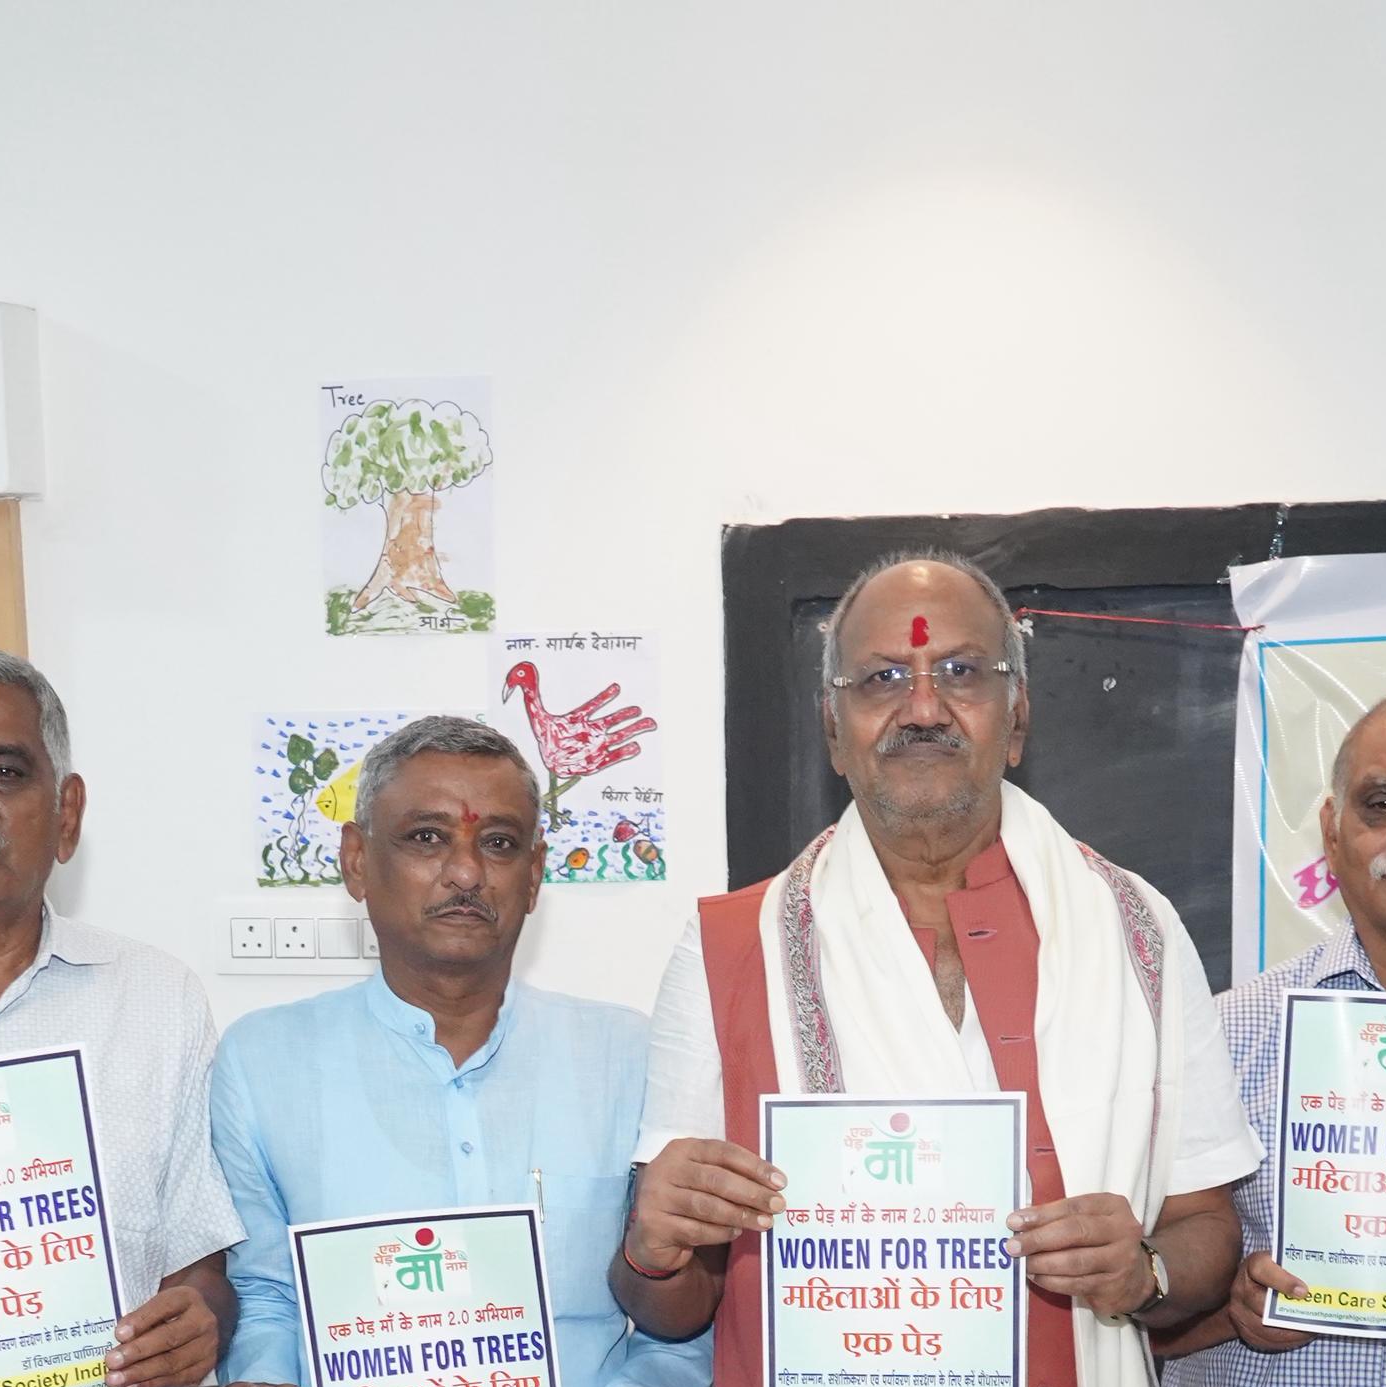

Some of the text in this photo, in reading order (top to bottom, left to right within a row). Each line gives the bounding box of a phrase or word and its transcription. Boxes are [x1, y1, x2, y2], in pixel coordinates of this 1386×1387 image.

[321, 385, 365, 408] Tree
[1292, 1121, 1377, 1155] WOMEN
[19, 1184, 97, 1227] TREES
[785, 1200, 995, 1226] एक पेड़ माँ के नाम 2.0 अभियान
[0, 1239, 33, 1270] के
[40, 1231, 95, 1265] लिए
[777, 1236, 1011, 1270] WOMEN FOR TREES
[0, 1286, 43, 1319] पेड़
[781, 1276, 1003, 1312] महिलाओं के लिए
[327, 1302, 524, 1341] एक पेड़ माँ के नाम 2.0 अभियान
[323, 1330, 545, 1381] WOMEN FOR TREES
[842, 1323, 942, 1361] एक पेड़
